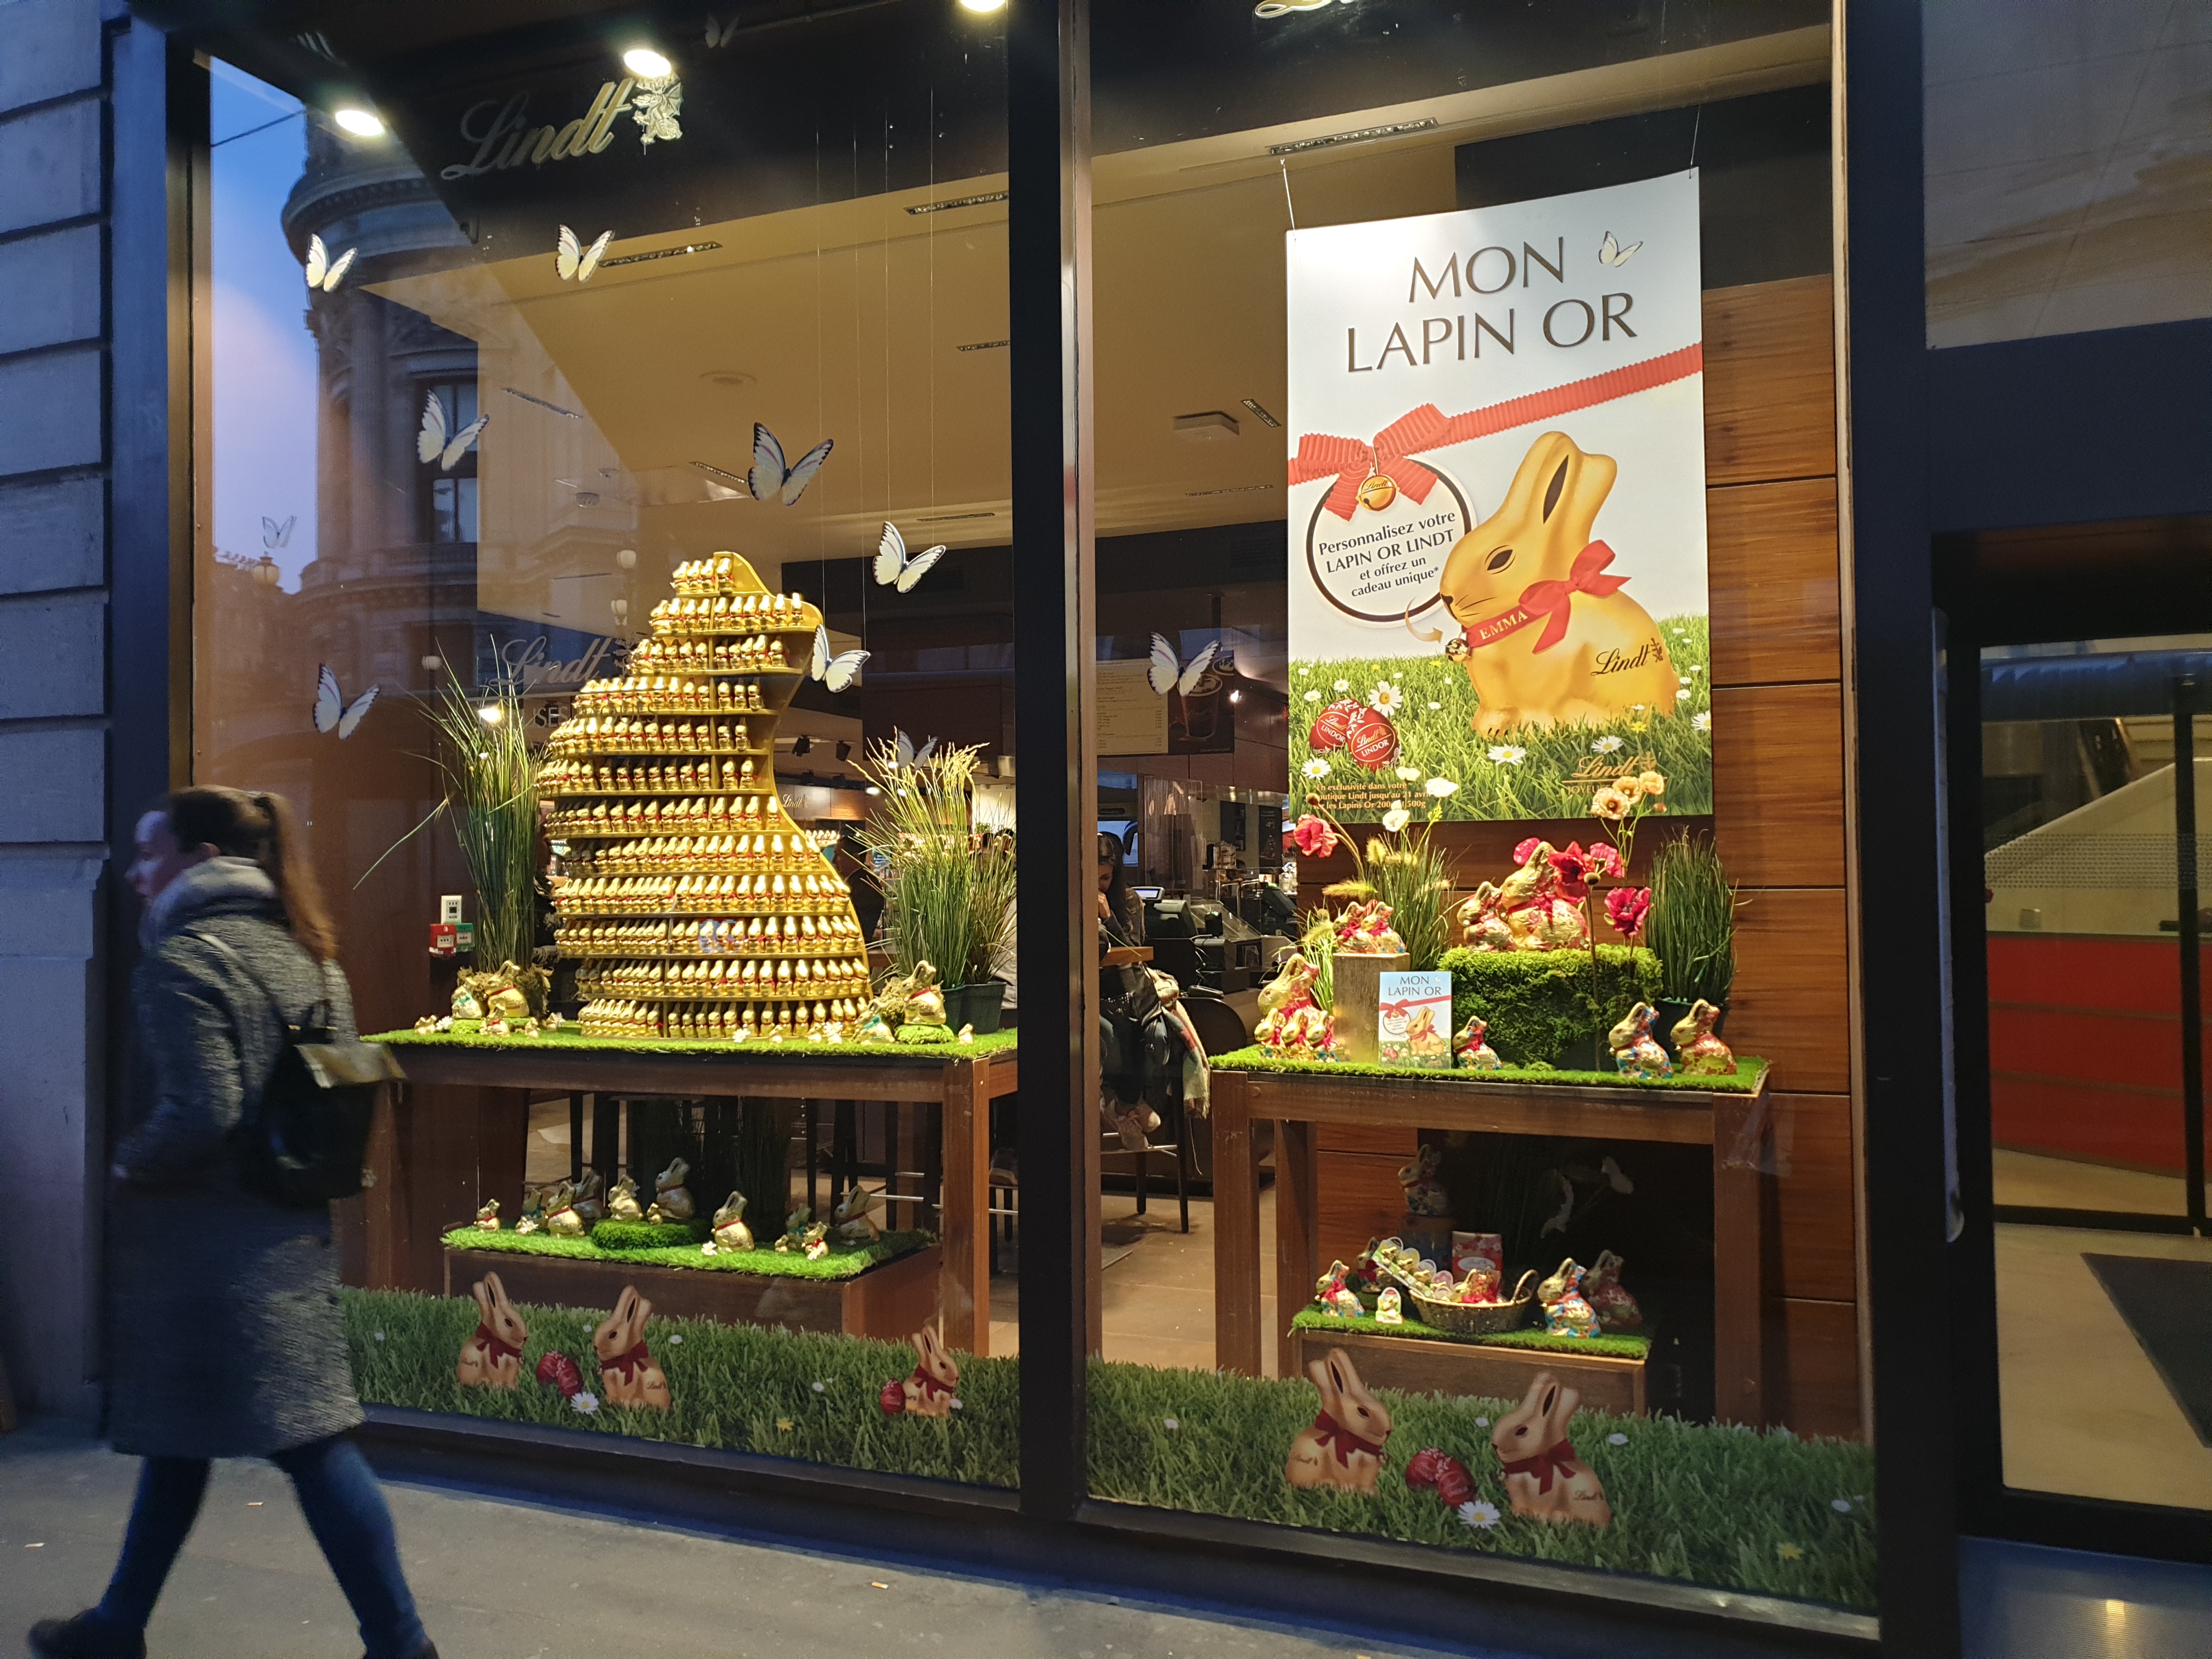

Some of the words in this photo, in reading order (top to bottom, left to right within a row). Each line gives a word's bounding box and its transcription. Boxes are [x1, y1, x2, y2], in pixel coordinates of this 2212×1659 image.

[441, 78, 634, 180] Lindt
[1408, 236, 1564, 303] MON
[1348, 308, 1515, 373] LAPIN
[1543, 292, 1638, 348] OR
[1364, 479, 1387, 491] Lindt
[1319, 523, 1414, 555] Personnalisez
[1419, 512, 1455, 529] votre
[1327, 551, 1372, 573] LAPIN
[1378, 546, 1402, 560] OR
[1407, 529, 1454, 552] LINDT
[1359, 569, 1370, 580] et
[1374, 561, 1408, 577] offrez
[1412, 556, 1426, 567] un
[1351, 580, 1391, 596] cadeau
[1480, 610, 1528, 640] EMMA
[489, 636, 612, 686] Lindt
[1591, 644, 1651, 676] Lindt
[1321, 724, 1346, 742] LINDOR
[1357, 729, 1379, 748] Lindt
[1361, 739, 1390, 757] LINDOR
[1571, 755, 1640, 777] Lindt
[782, 794, 803, 808] Lindt
[1318, 792, 1346, 802] outique
[1339, 801, 1362, 811] Lapins
[1407, 800, 1426, 809] 500g
[1400, 975, 1429, 985] MON
[1388, 986, 1420, 996] LAPIN
[1425, 986, 1441, 995] OR
